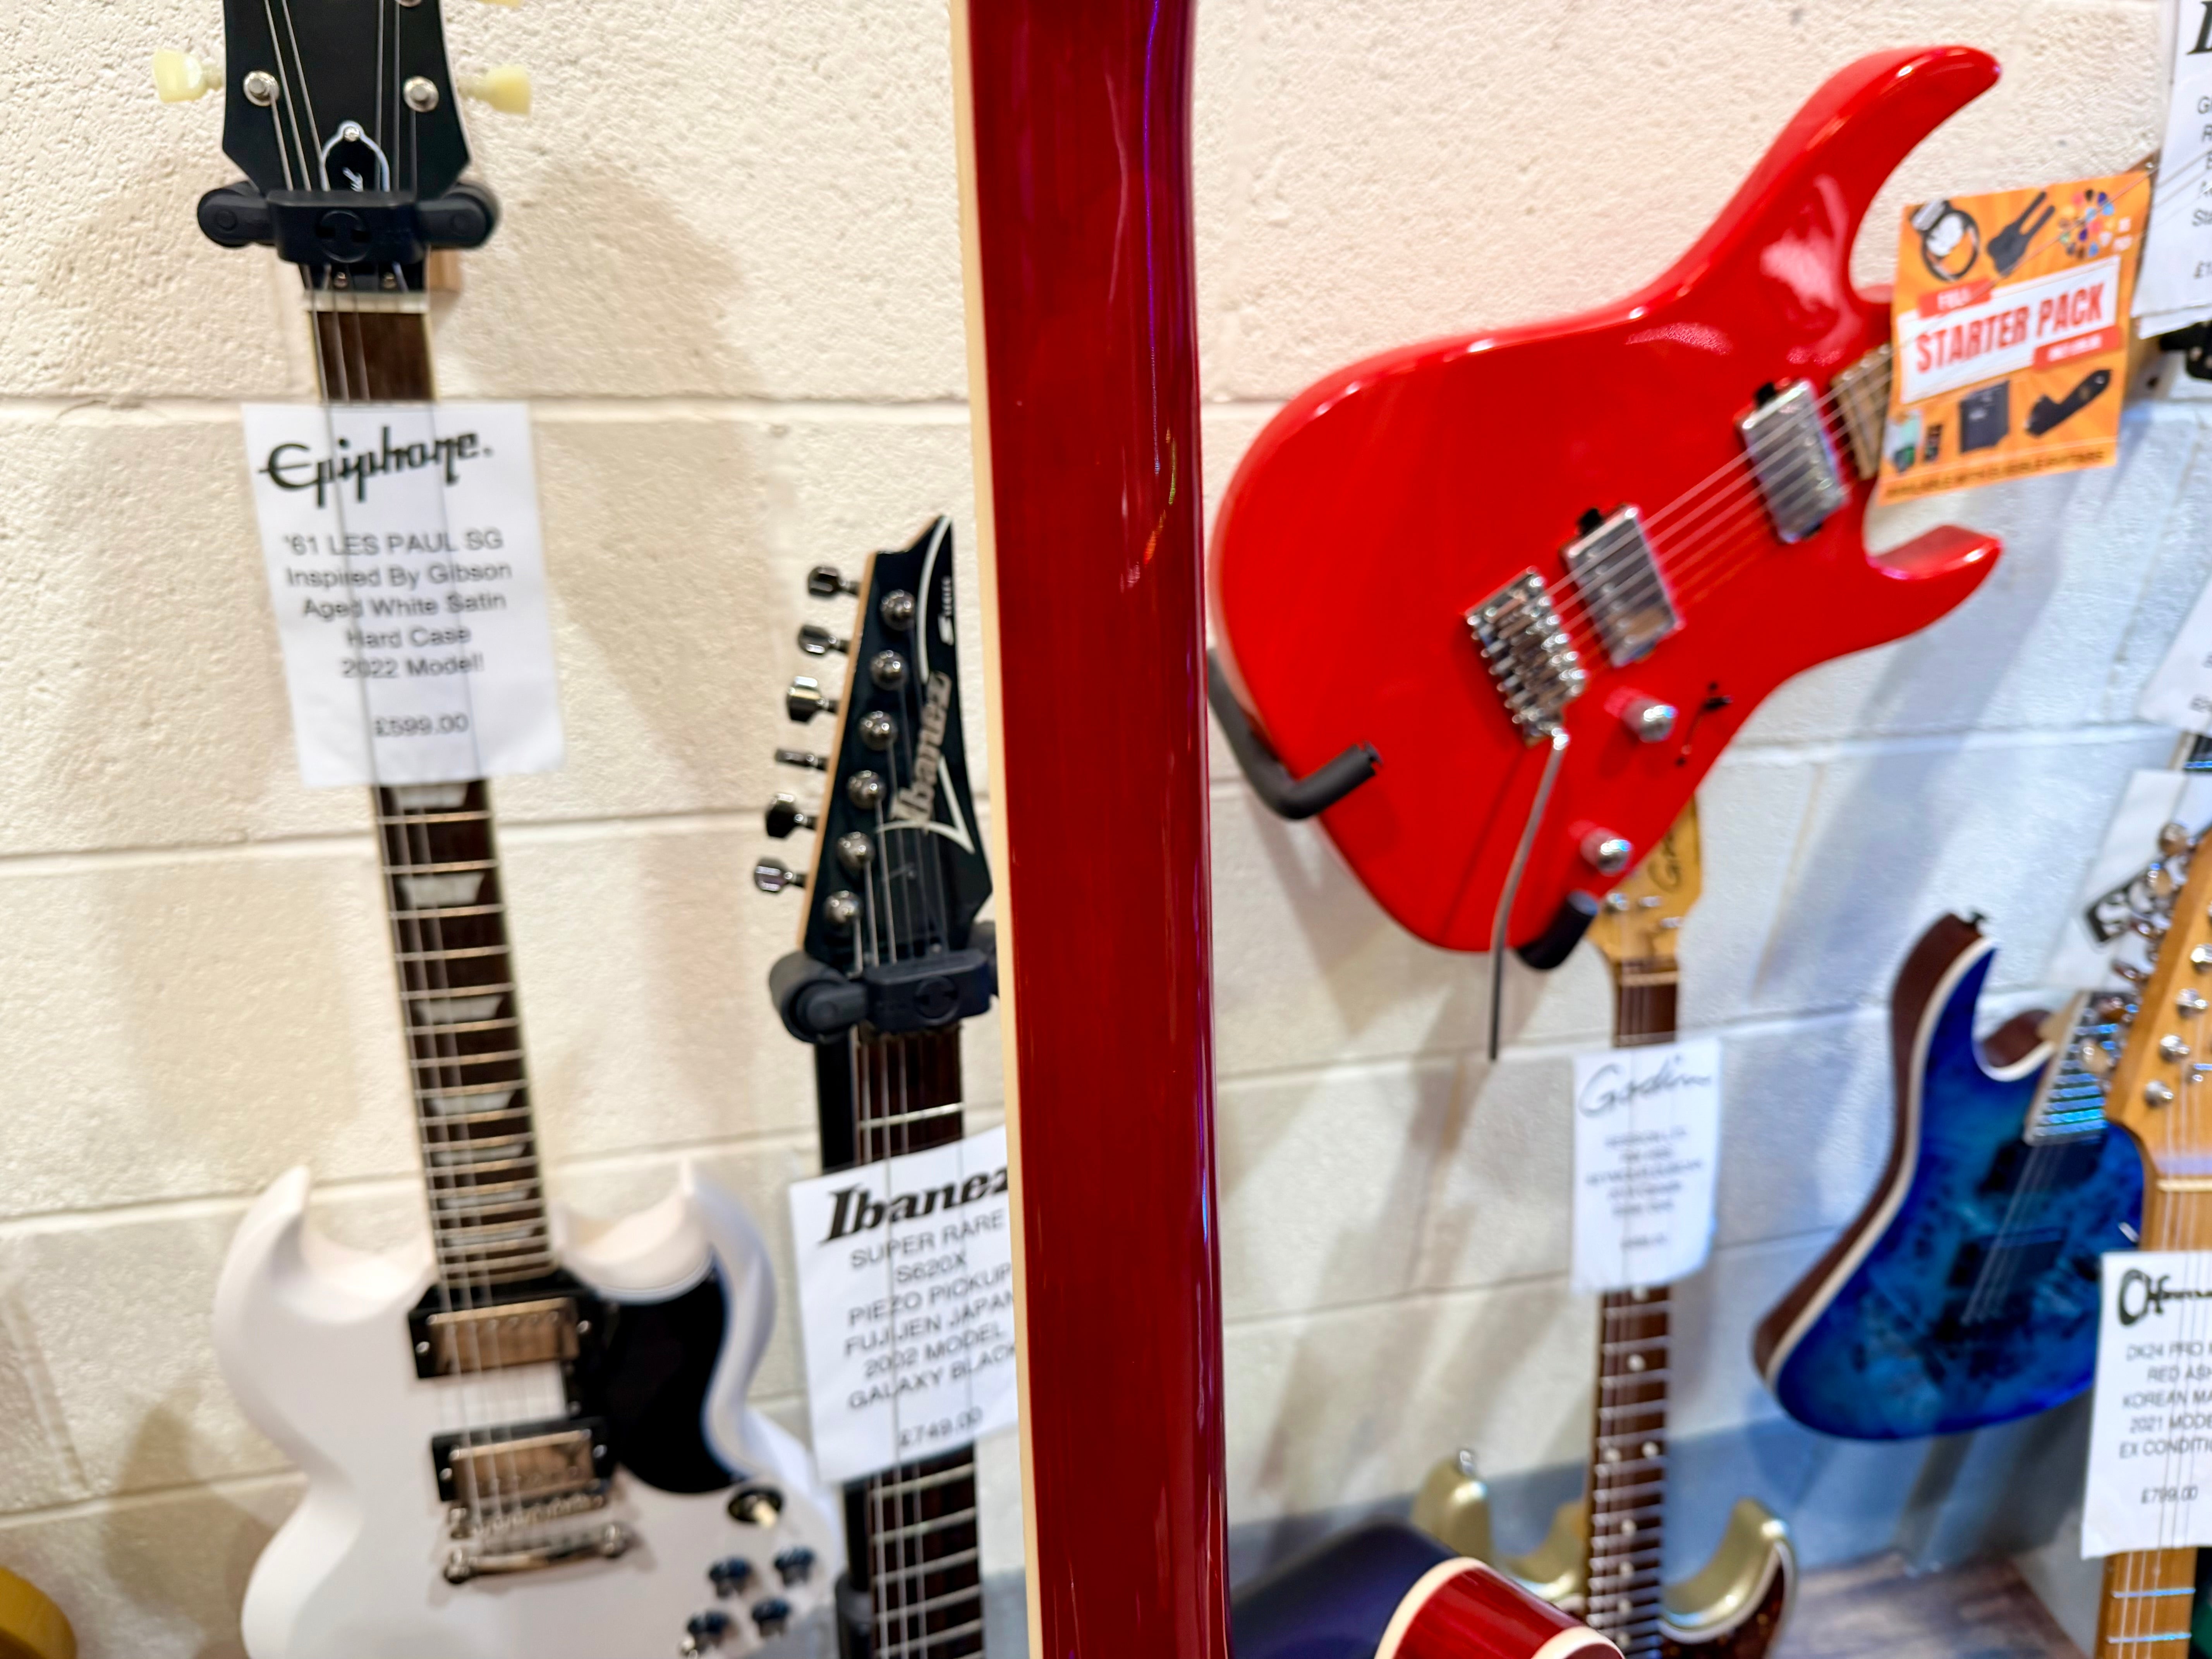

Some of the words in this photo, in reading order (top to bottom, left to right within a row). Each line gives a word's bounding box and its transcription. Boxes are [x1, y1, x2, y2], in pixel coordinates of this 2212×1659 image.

[1915, 310, 2028, 373] STARTER
[2036, 283, 2105, 339] PACK
[329, 534, 379, 556] LES
[388, 532, 458, 555] PAUL
[465, 527, 503, 551] SG
[287, 566, 381, 591] Inspired
[390, 565, 420, 591] By
[428, 561, 512, 584] Gibson
[302, 597, 363, 620] Aged
[372, 596, 438, 618] White
[447, 591, 507, 614] Satin
[346, 628, 401, 650] Hard
[409, 625, 471, 647] Case
[341, 658, 398, 679] 2022
[374, 713, 470, 739] £599.00
[891, 671, 952, 834] Ibanez
[850, 1231, 935, 1269] SUPER
[942, 1207, 1005, 1245] RARE
[847, 1291, 923, 1328] PIEZO
[924, 1321, 1006, 1360] MODEL
[848, 1365, 943, 1409] GALAXY
[2123, 1390, 2187, 1410] KOREAN
[2169, 1413, 2212, 1431] MODE
